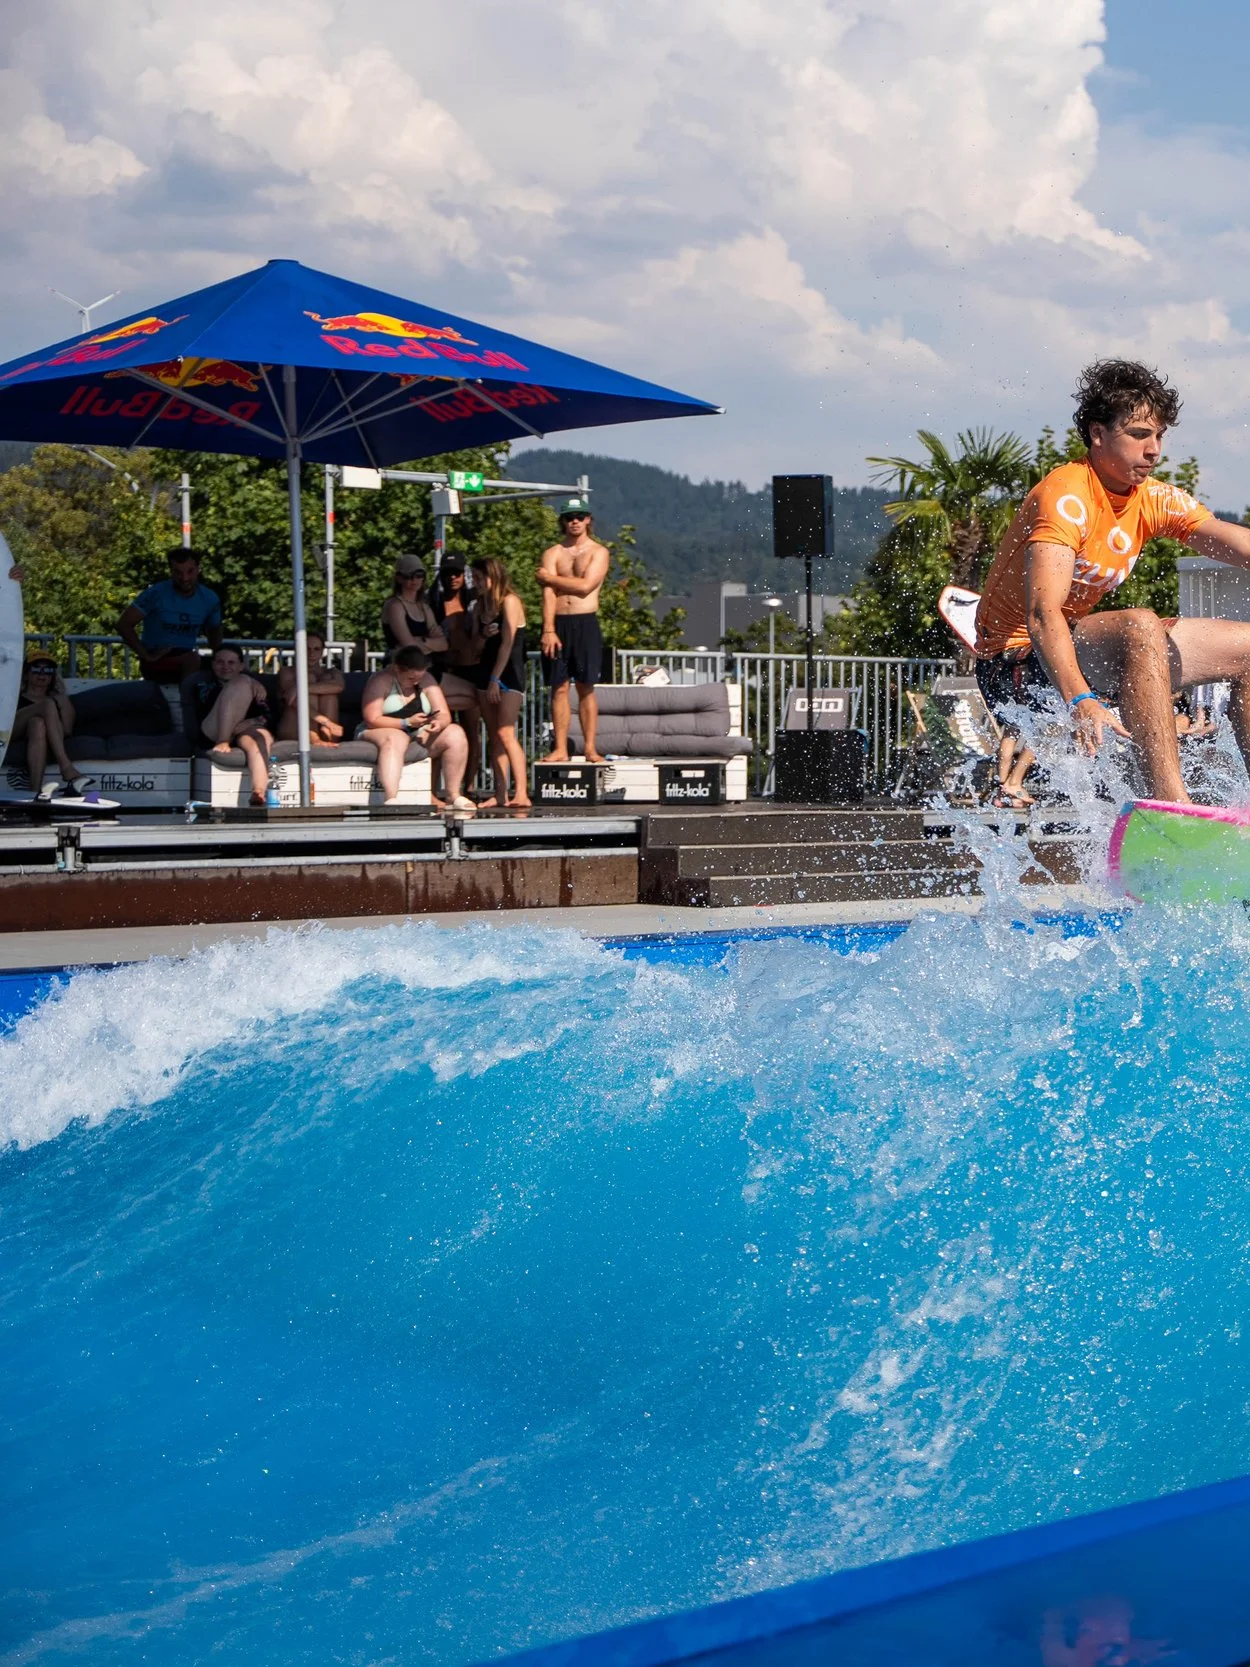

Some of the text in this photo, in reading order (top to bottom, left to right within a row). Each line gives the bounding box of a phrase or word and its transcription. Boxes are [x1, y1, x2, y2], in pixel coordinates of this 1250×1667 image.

[320, 334, 440, 359] Red
[100, 774, 156, 790] fritz-kola
[665, 782, 710, 798] fritz-kola
[541, 783, 588, 799] fritz-kola
